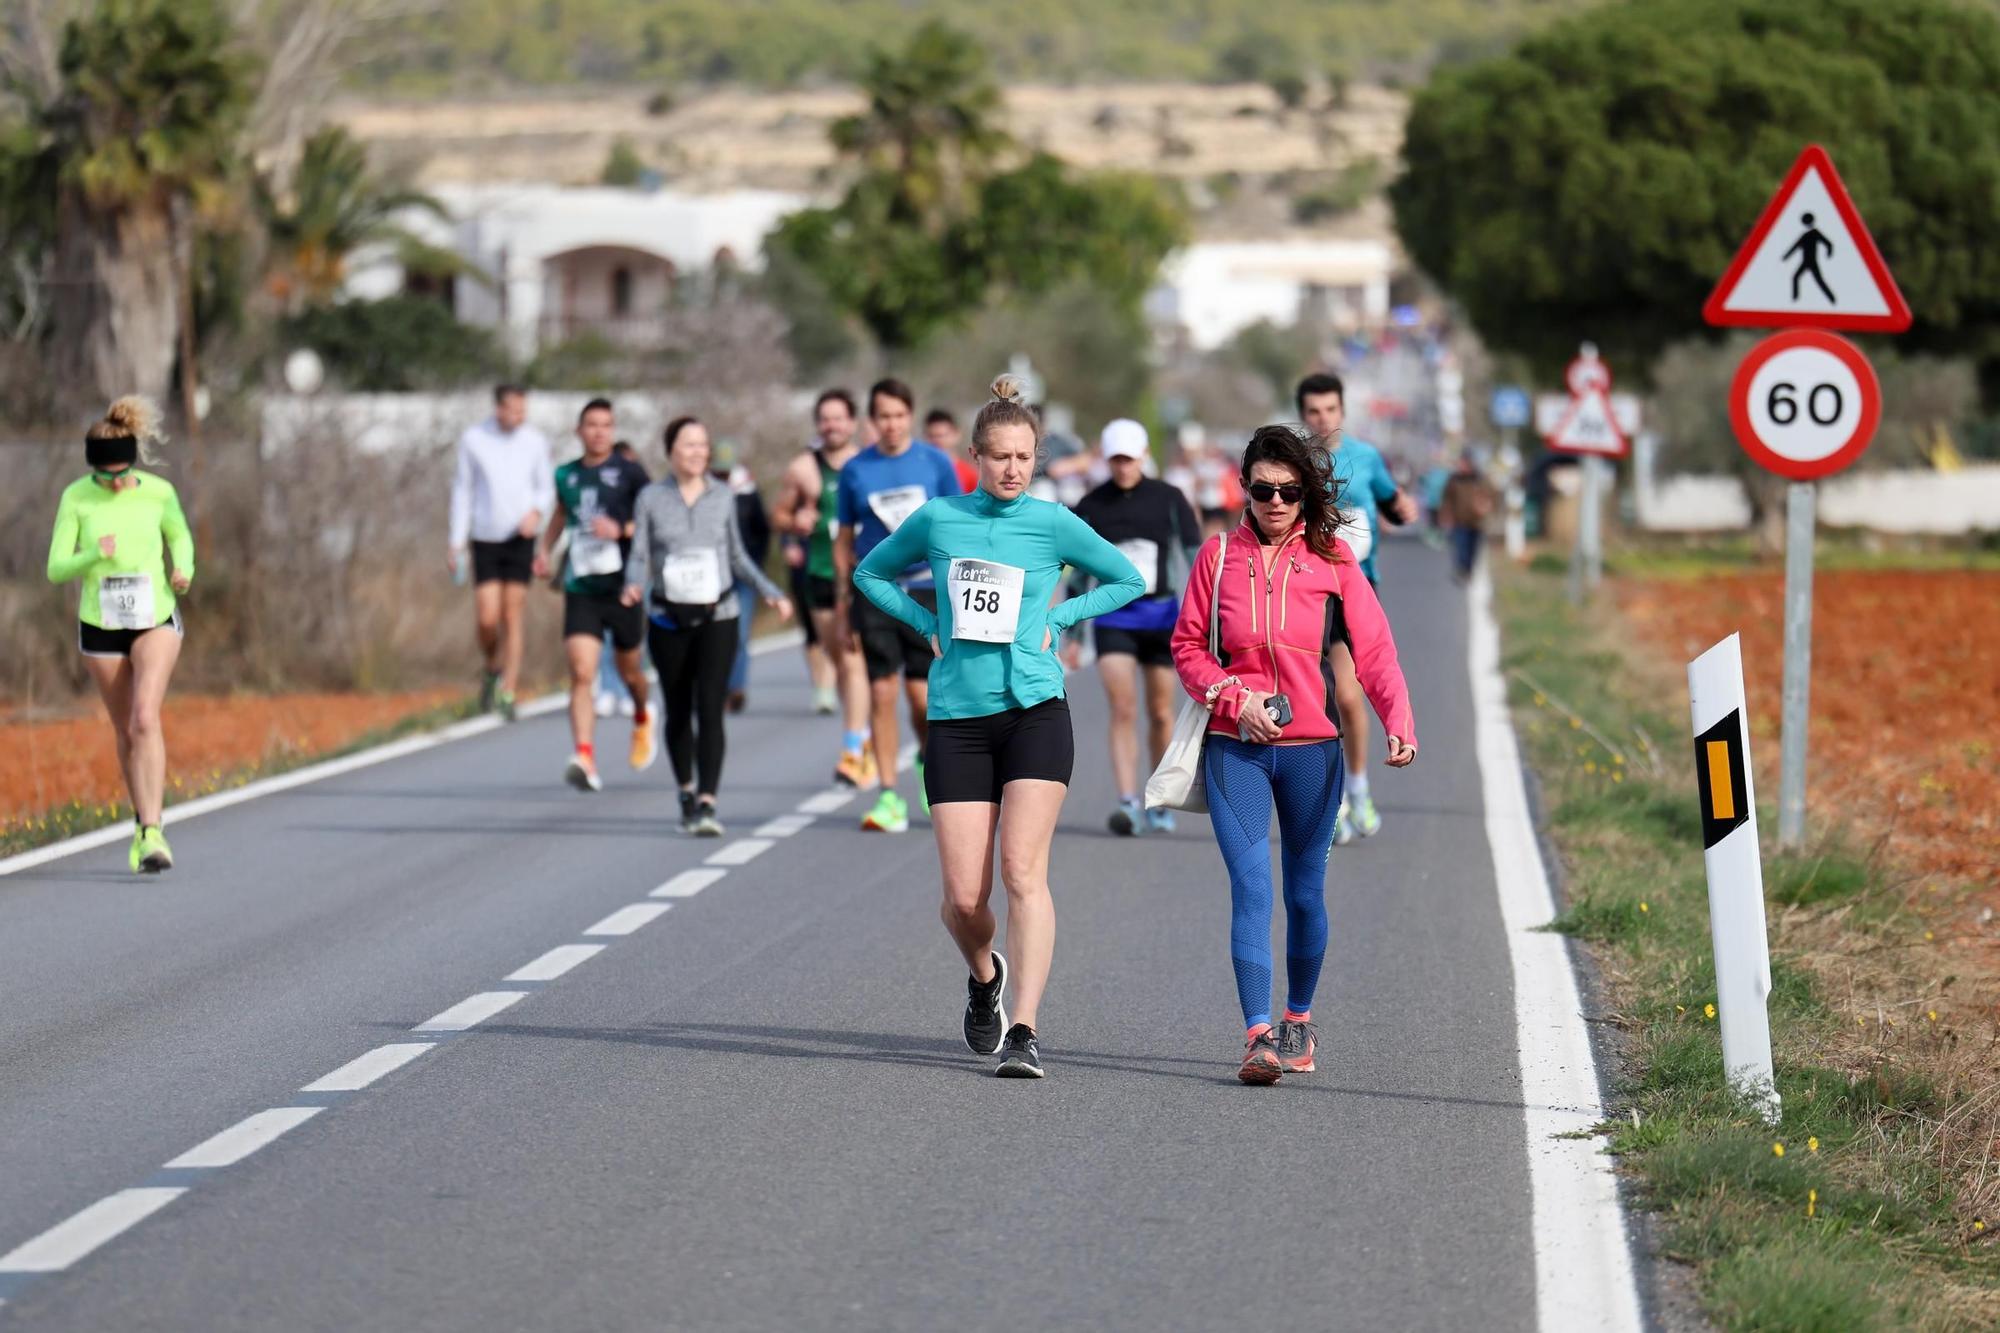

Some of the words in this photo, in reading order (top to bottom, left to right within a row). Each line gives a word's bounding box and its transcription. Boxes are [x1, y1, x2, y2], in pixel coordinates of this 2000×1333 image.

[1767, 383, 1842, 425] 60
[119, 595, 135, 610] 39
[962, 588, 1000, 613] 158
